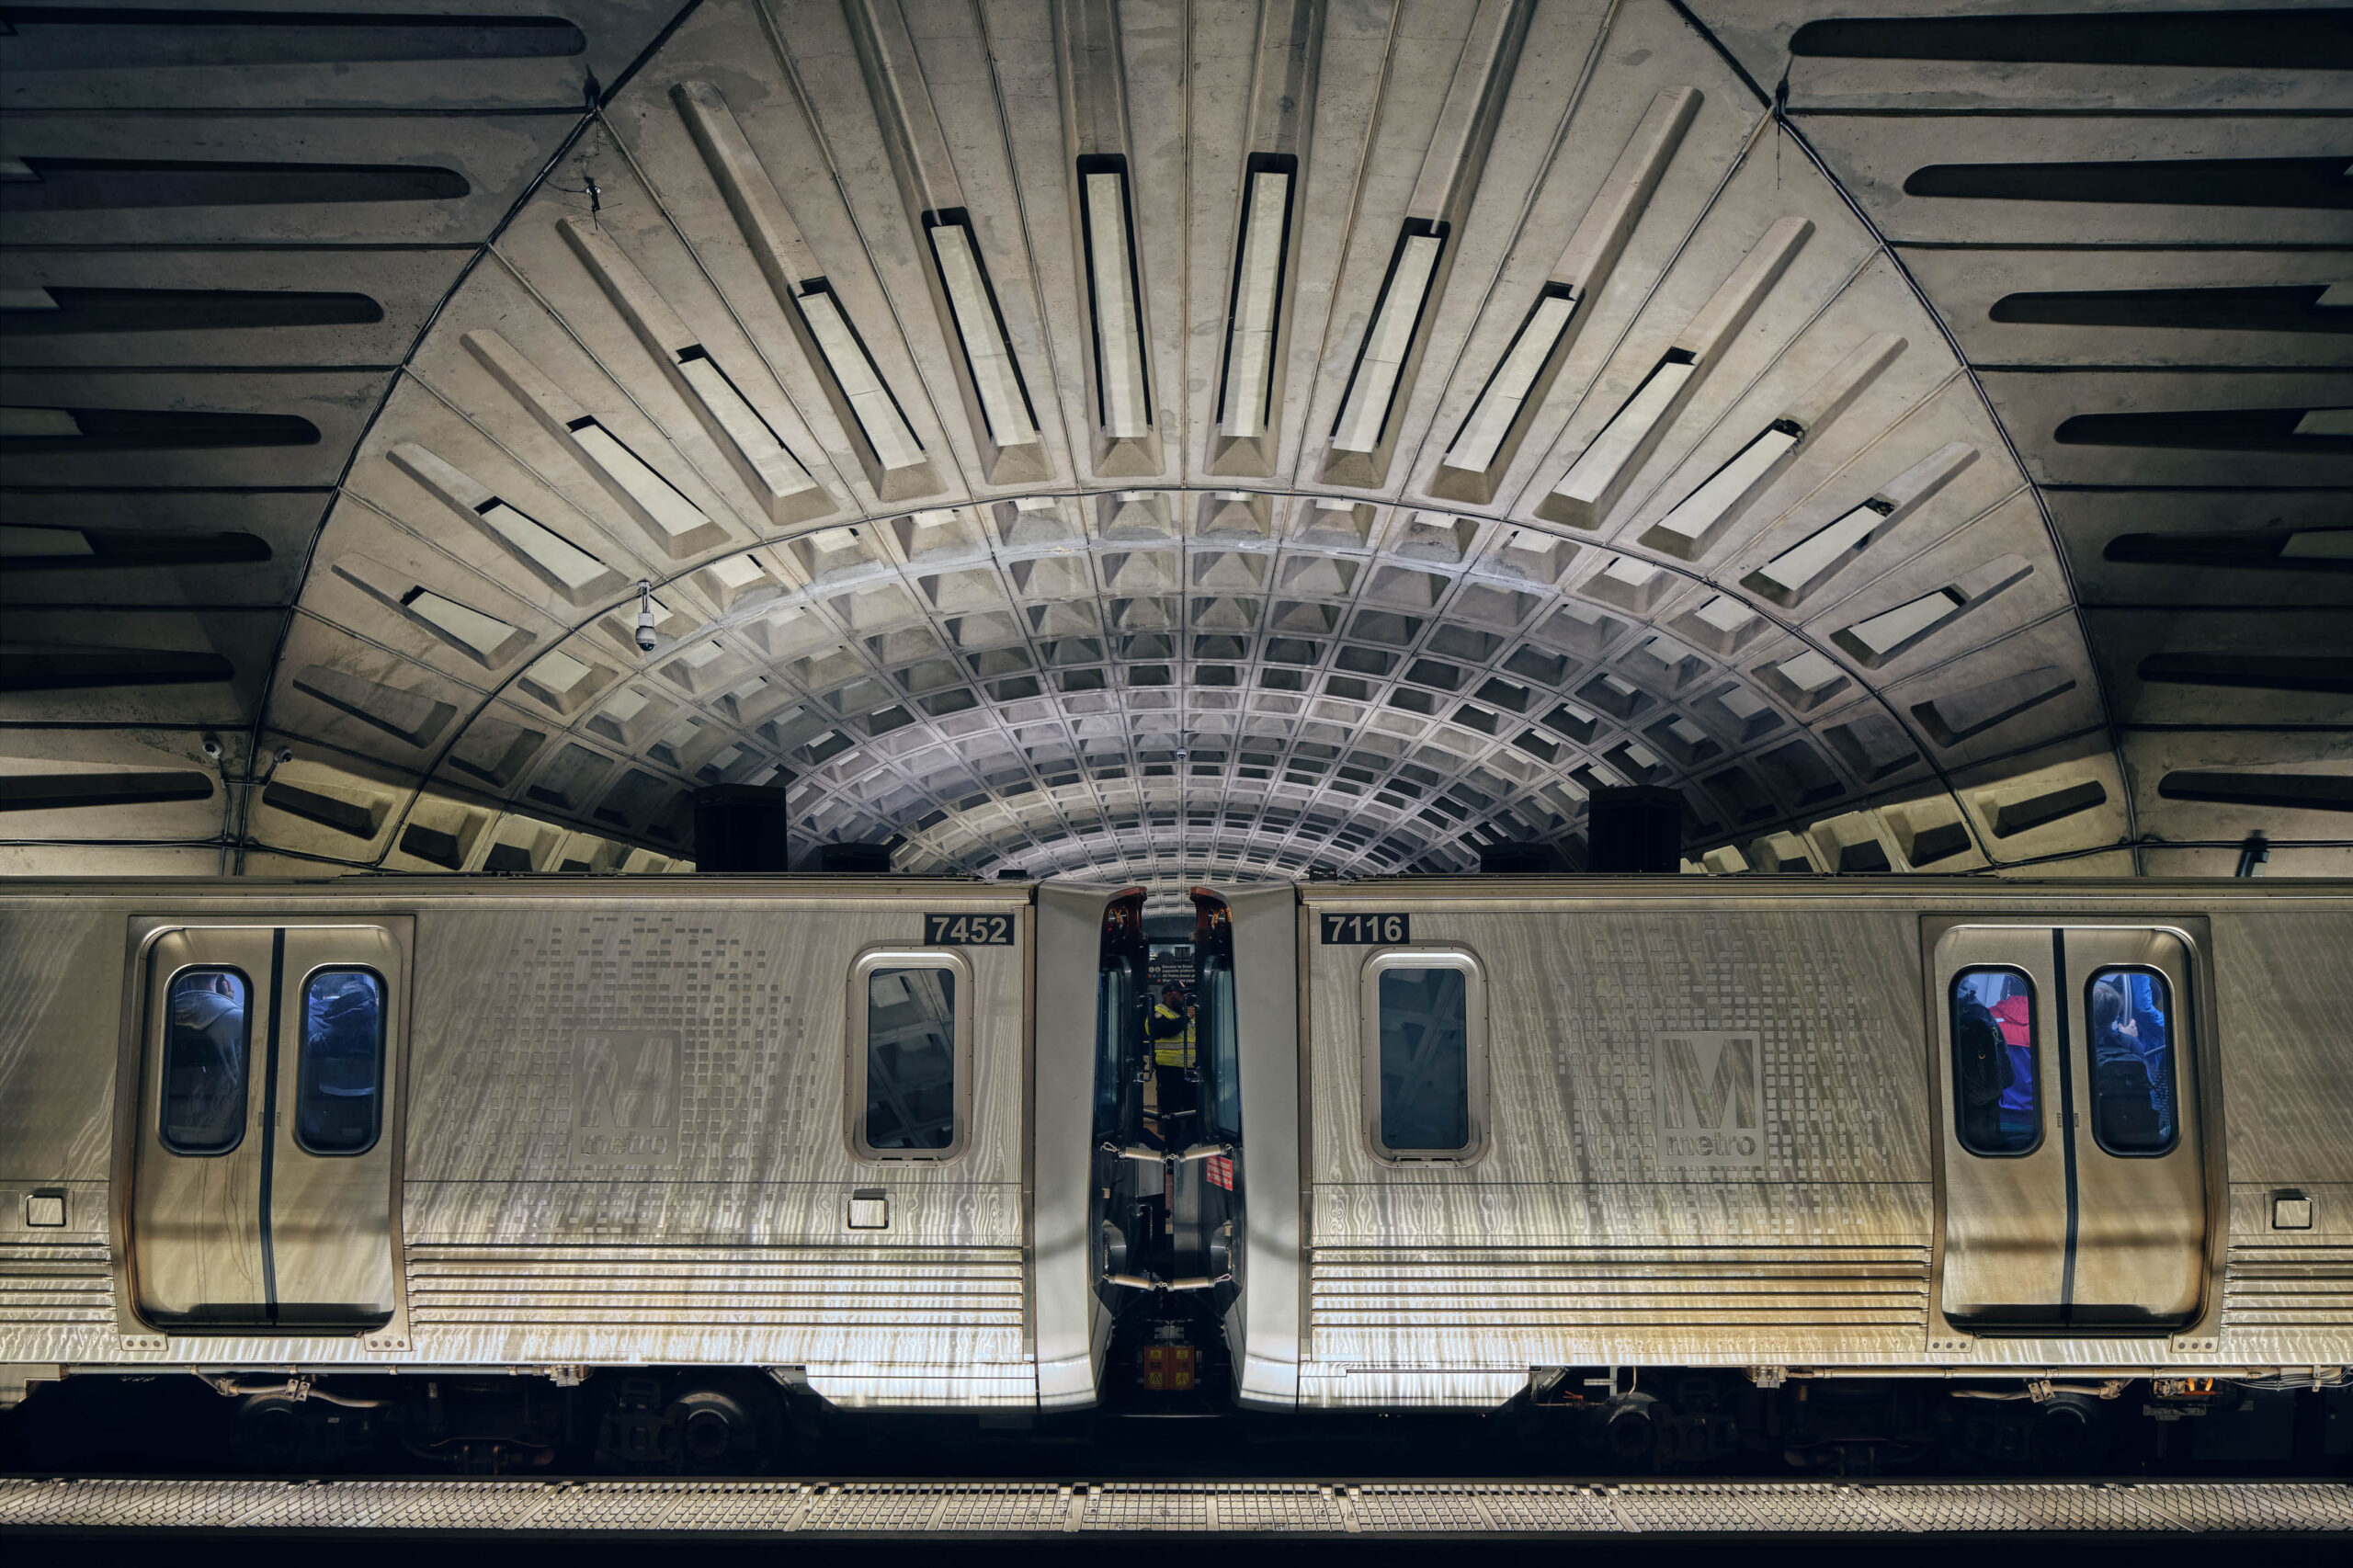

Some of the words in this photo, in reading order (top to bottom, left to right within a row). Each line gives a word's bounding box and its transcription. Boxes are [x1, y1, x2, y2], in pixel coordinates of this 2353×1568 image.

[932, 916, 1007, 943] 7452
[1328, 915, 1402, 942] 7116
[581, 1038, 672, 1128] M
[1662, 1039, 1756, 1129] M
[581, 1131, 667, 1154] metro
[1666, 1131, 1756, 1156] metro
